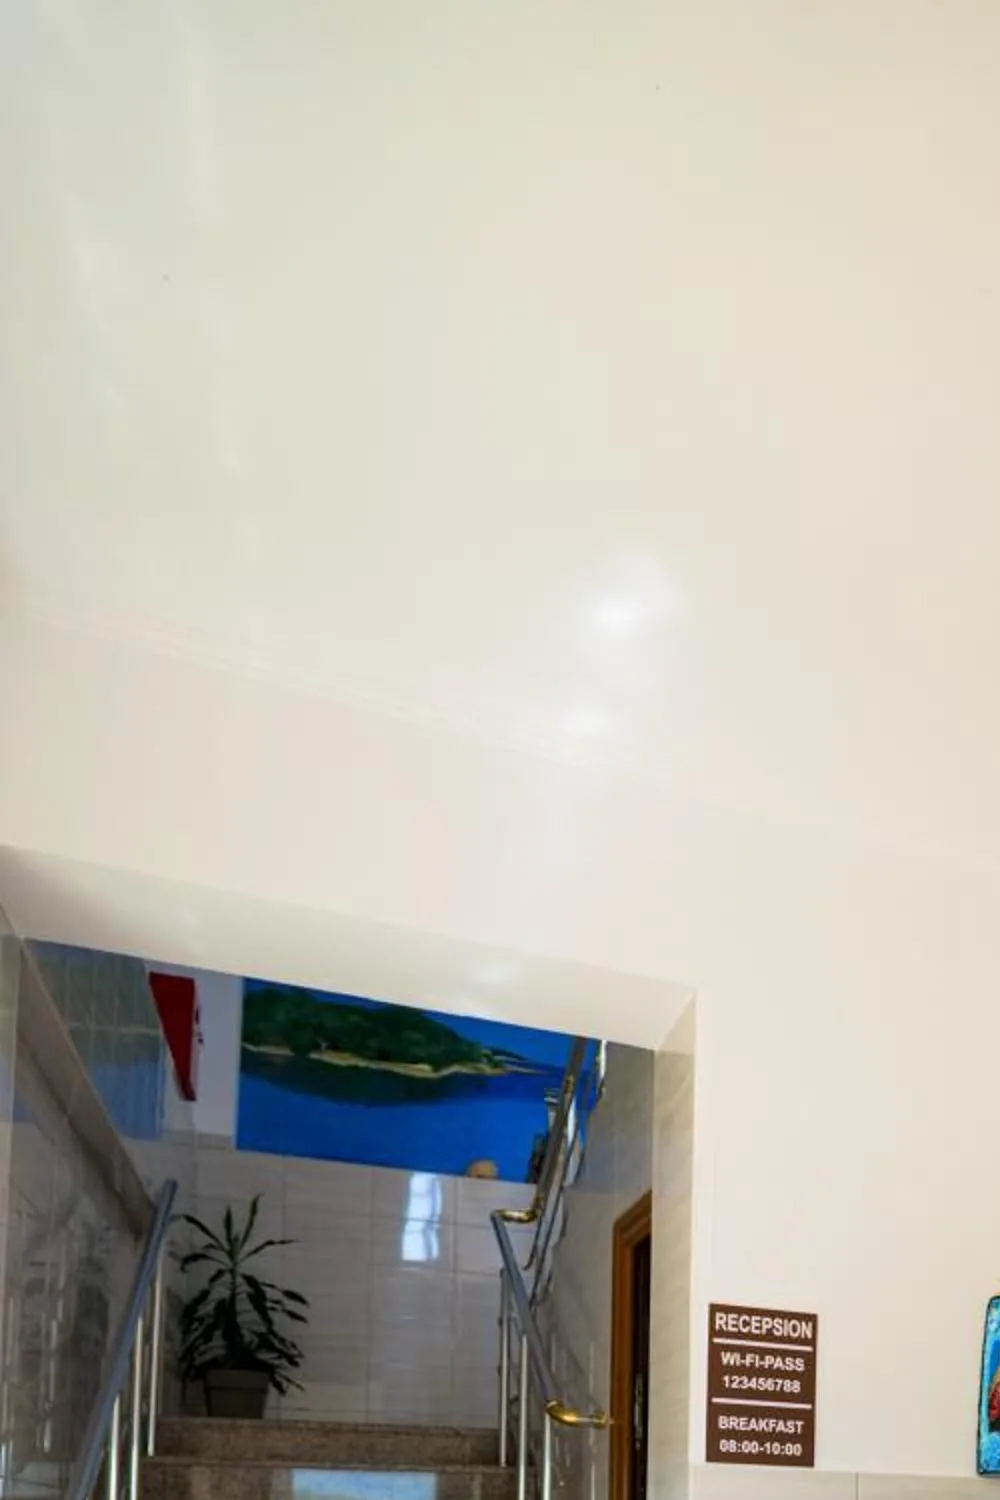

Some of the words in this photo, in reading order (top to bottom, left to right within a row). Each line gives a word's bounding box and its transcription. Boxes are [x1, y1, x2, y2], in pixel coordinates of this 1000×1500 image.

[715, 1312, 813, 1339] RECEPSION
[721, 1351, 805, 1372] WI-FI-PASS
[718, 1415, 805, 1435] BREAKFAST
[719, 1439, 803, 1457] 08:00-10:00
